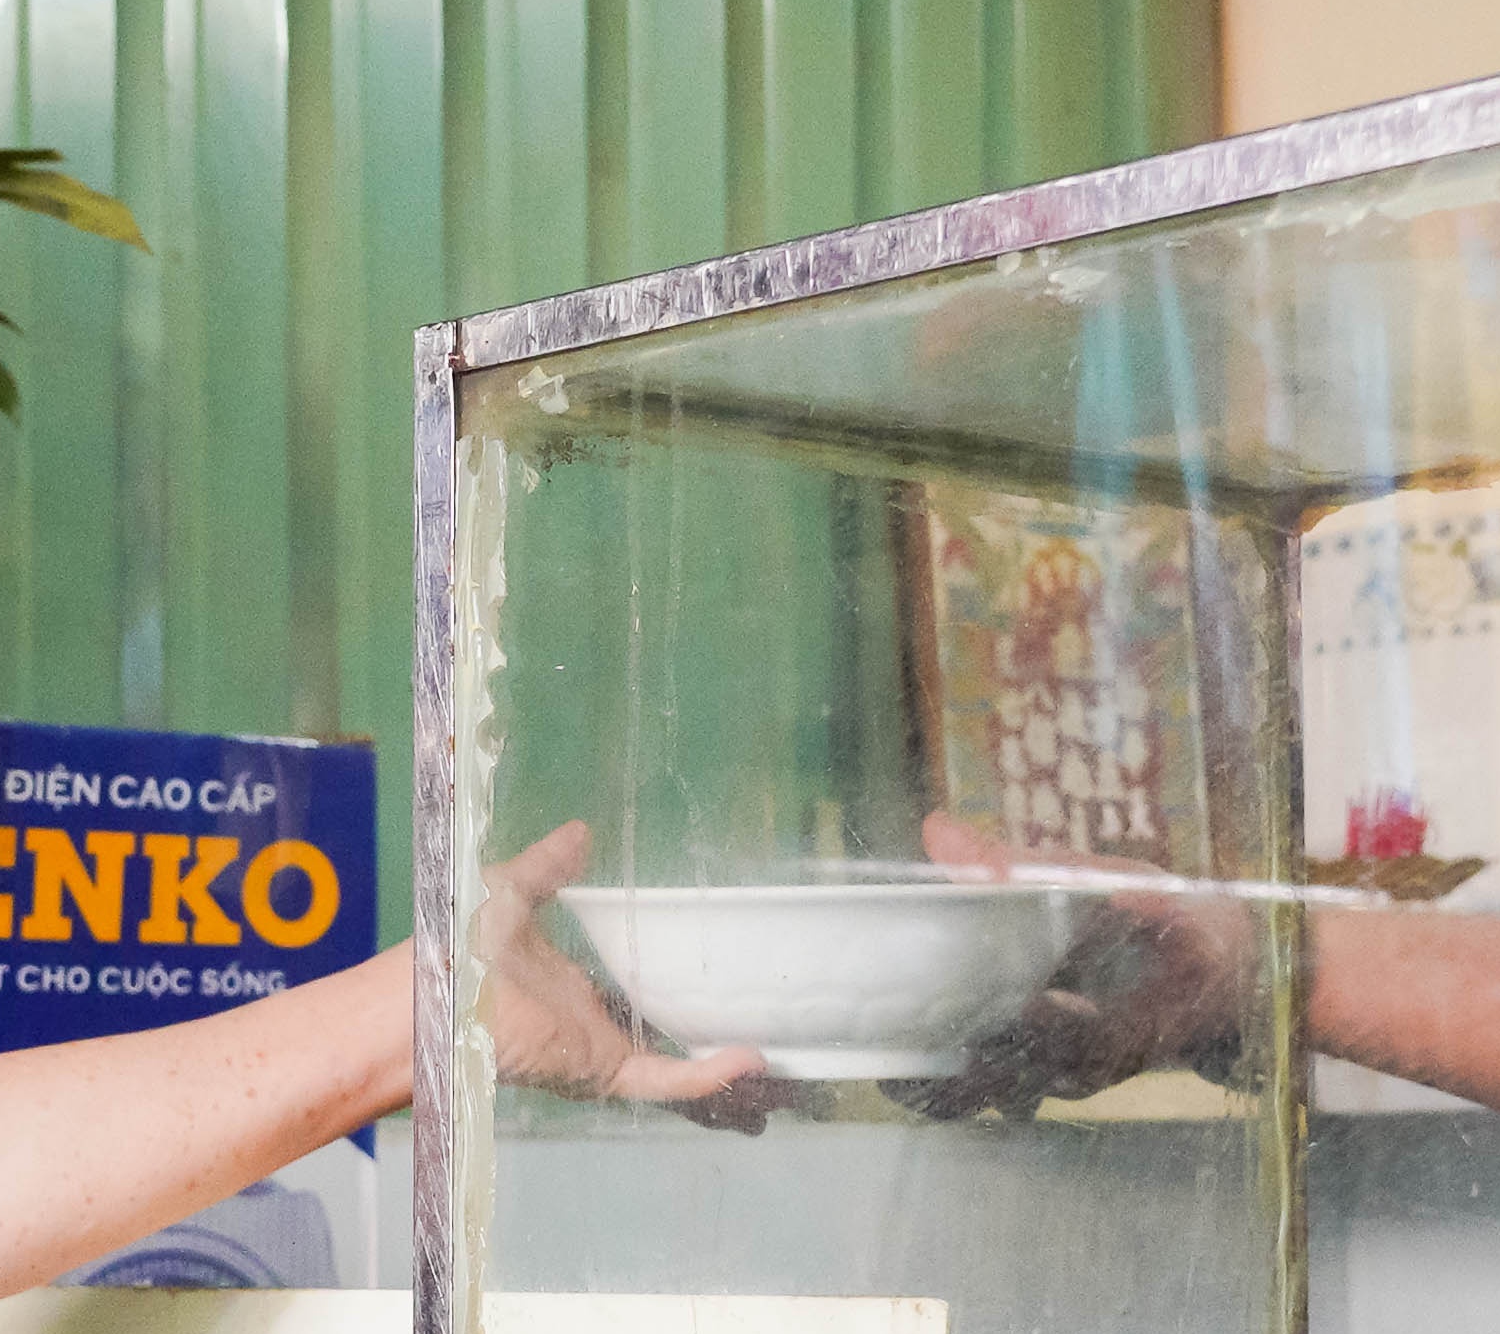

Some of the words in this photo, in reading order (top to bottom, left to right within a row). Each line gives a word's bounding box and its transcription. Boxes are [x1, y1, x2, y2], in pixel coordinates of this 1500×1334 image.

[5, 763, 101, 812] ĐIỆN
[109, 774, 192, 812] CAO
[15, 964, 90, 993] CHO
